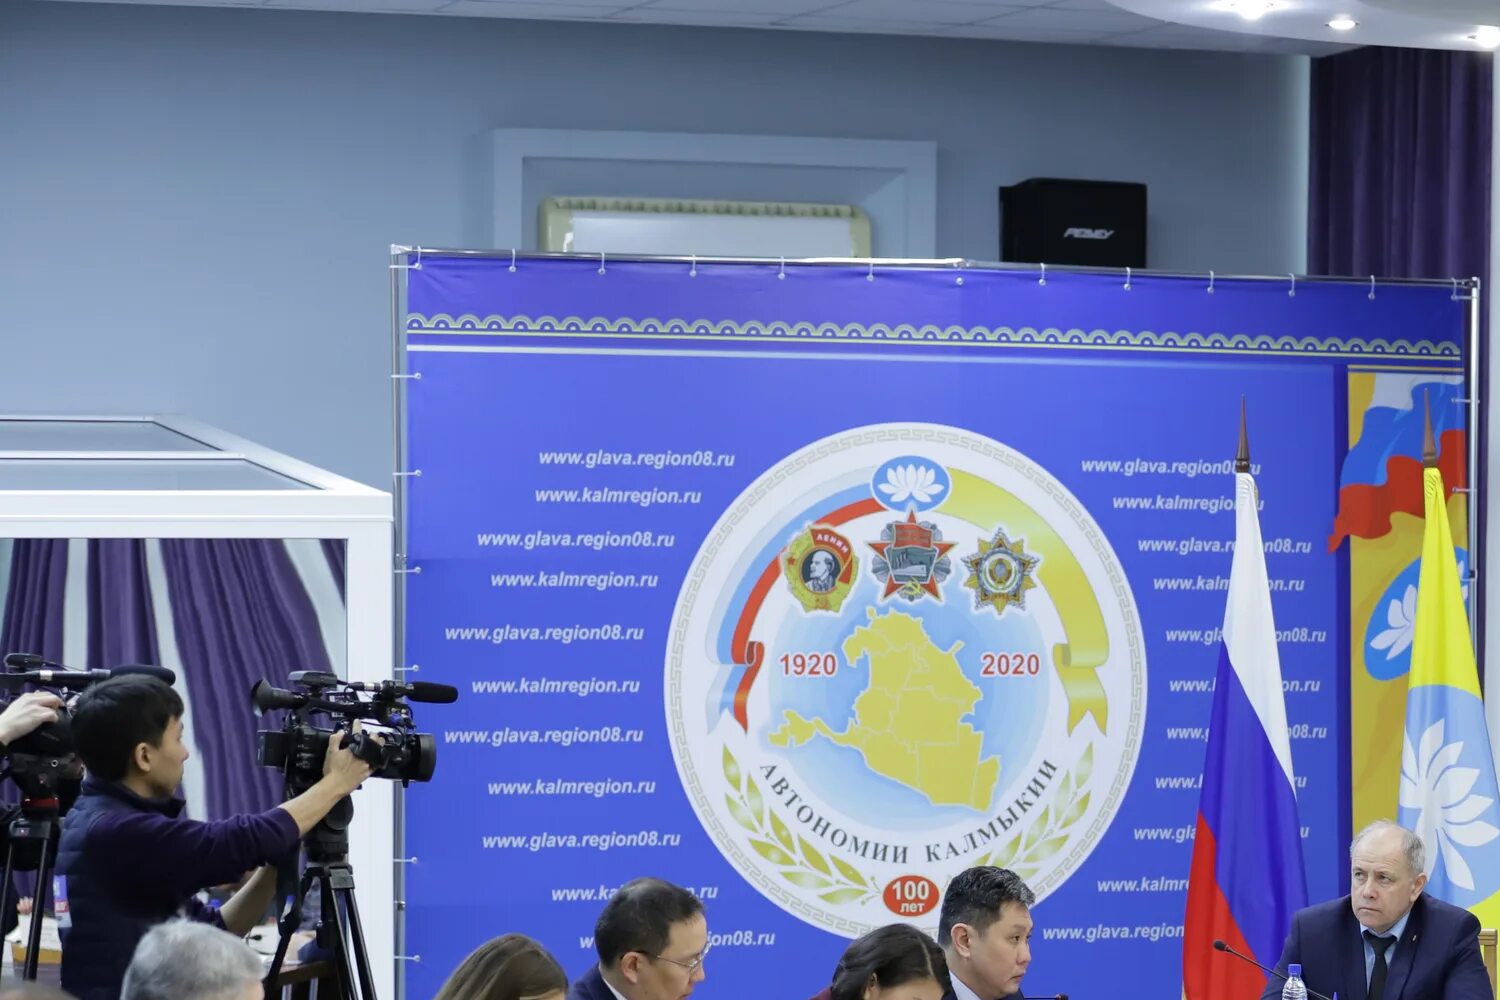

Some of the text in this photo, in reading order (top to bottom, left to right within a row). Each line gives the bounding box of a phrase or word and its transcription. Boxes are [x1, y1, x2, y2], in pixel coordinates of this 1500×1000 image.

[539, 450, 735, 469] www.glava.region08.ru
[1082, 458, 1261, 477] www.glava.region0u
[535, 487, 701, 507] www.kalmregion.ru
[1113, 495, 1265, 513] www.kalmregiou
[477, 531, 675, 550] www.glava.region08.ru
[491, 571, 658, 591] www.kalmregion.ru
[445, 624, 644, 644] www.glava.region08.ru
[780, 654, 837, 675] 1920
[982, 654, 1040, 676] 2020
[472, 677, 640, 697] www.kalmregion.ru
[444, 727, 643, 747] www.glava.region08.ru
[488, 779, 656, 798] www.kalmregion.ru
[760, 760, 1058, 864] АВТОНОМИИ КАЛМЫКИИ
[482, 831, 680, 851] www.glava.region08.ru
[892, 881, 929, 900] 100
[900, 902, 925, 914] лет
[1042, 923, 1185, 943] www.glava.region
